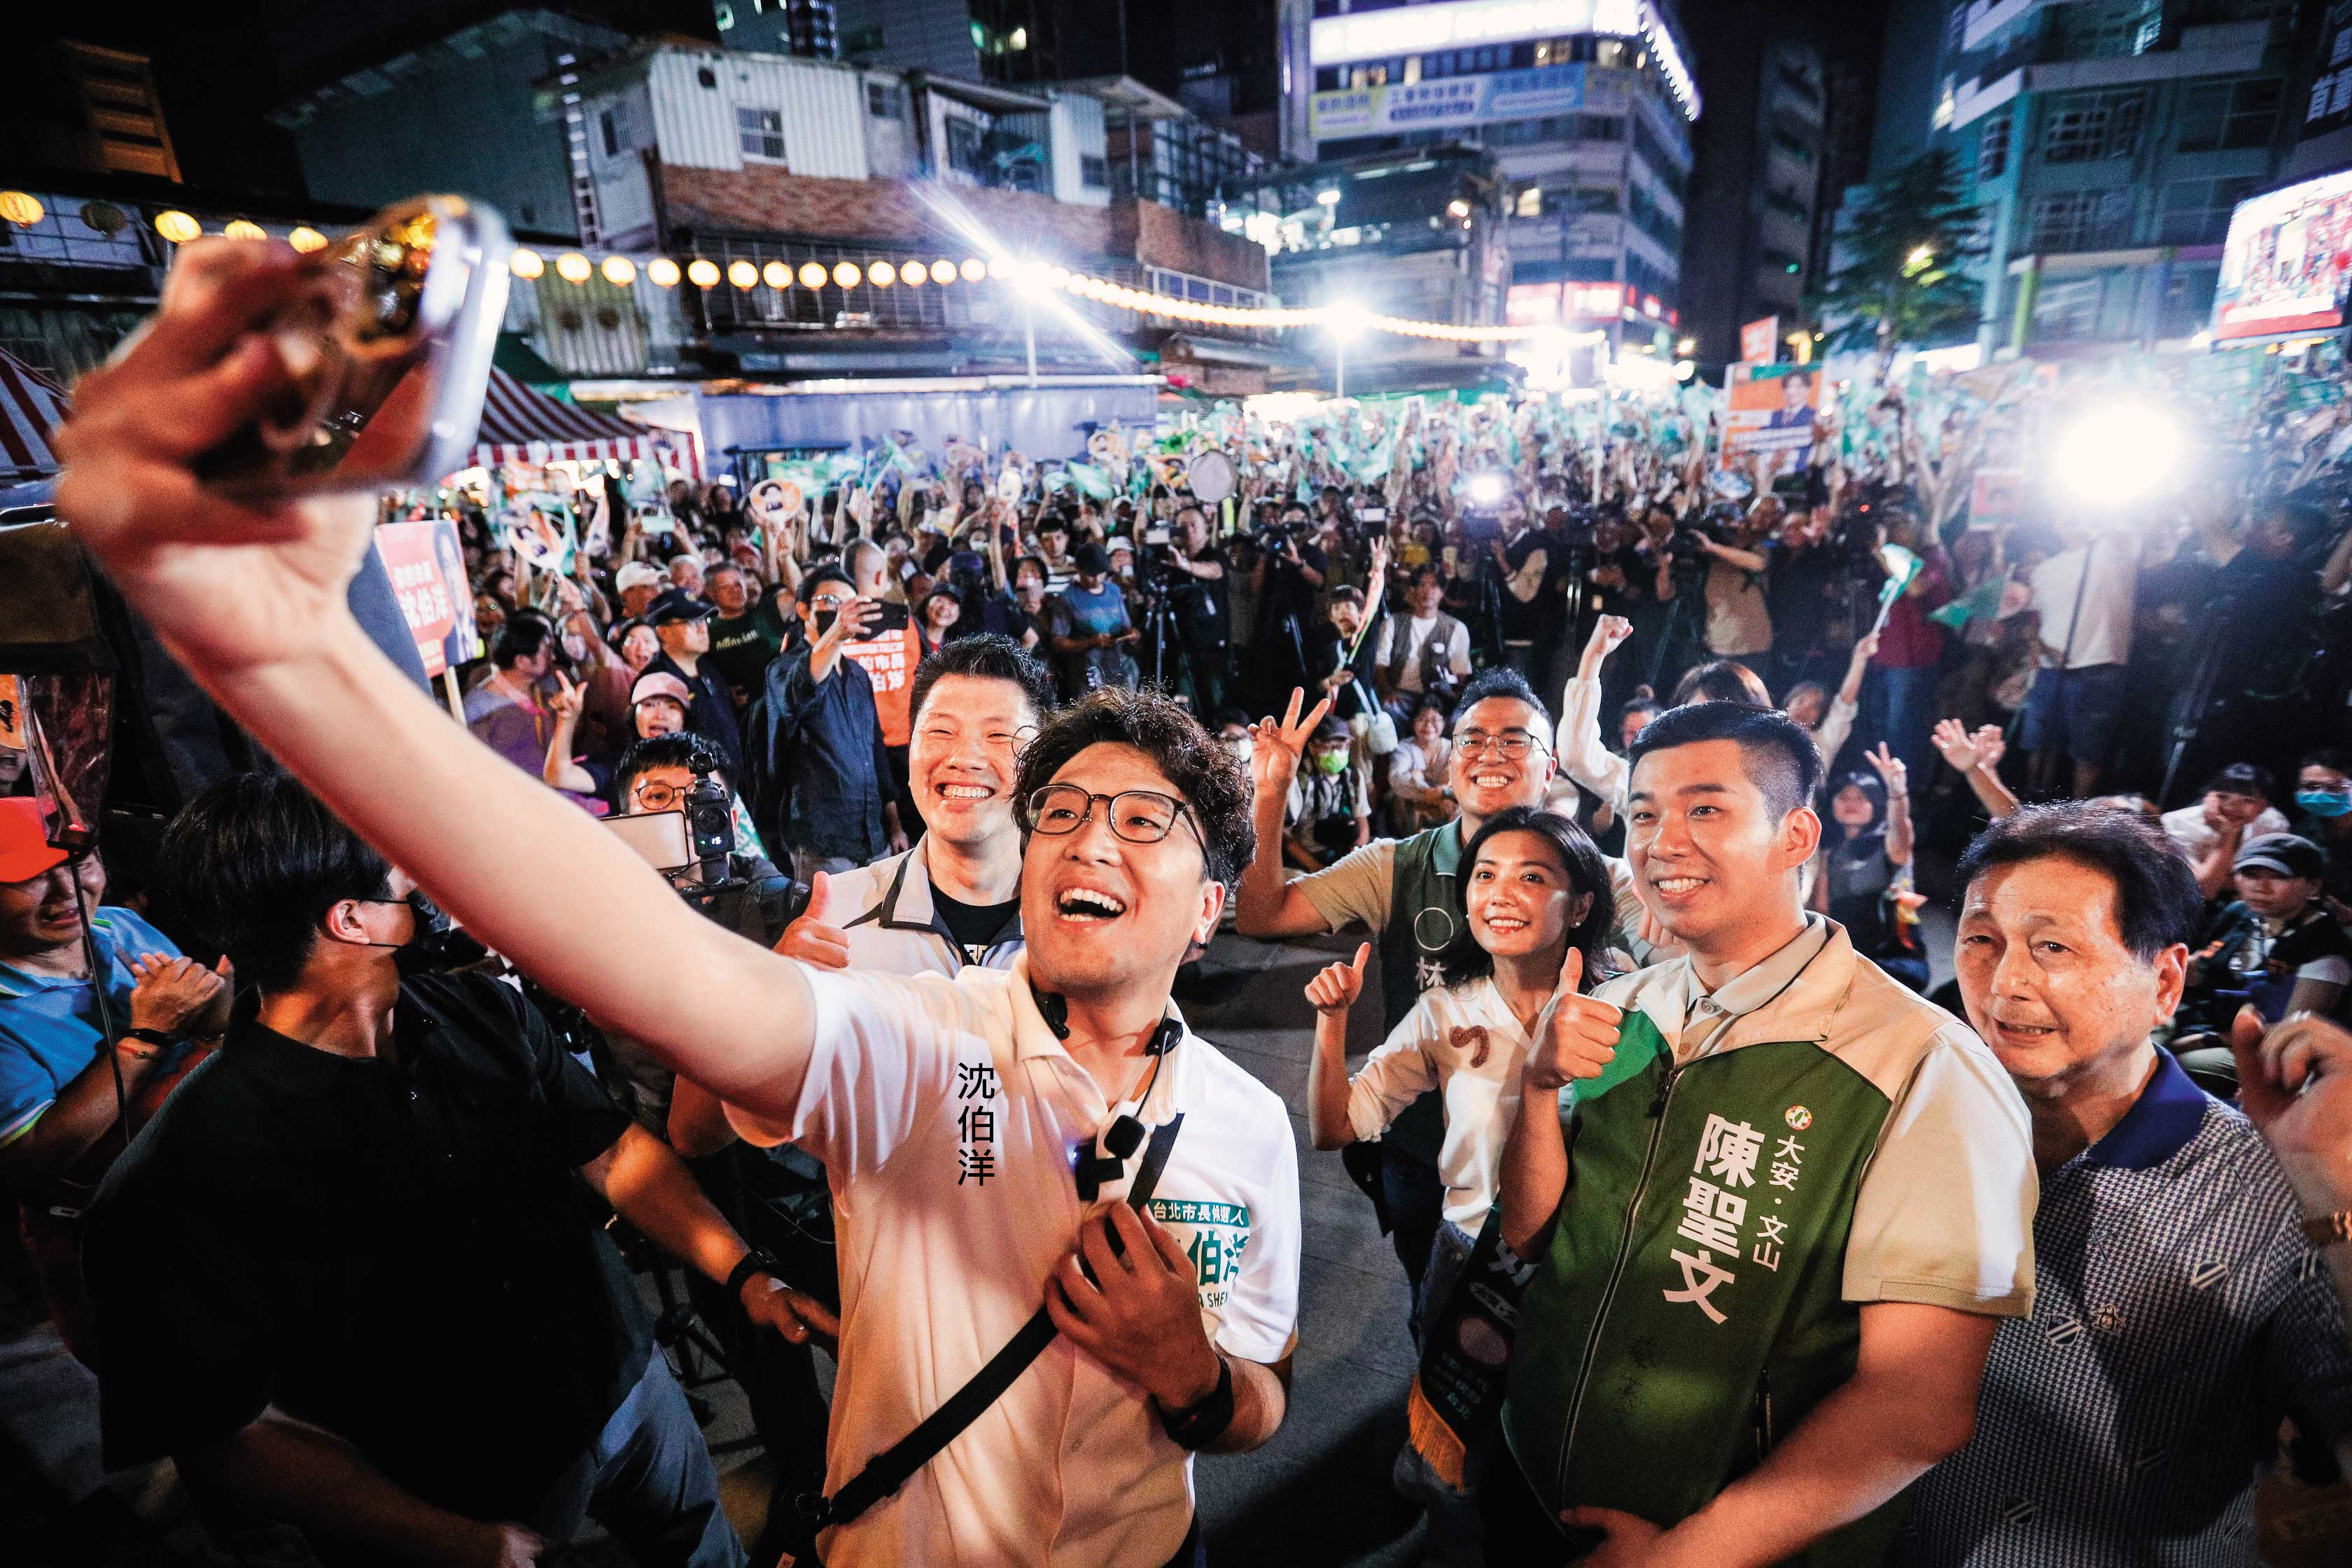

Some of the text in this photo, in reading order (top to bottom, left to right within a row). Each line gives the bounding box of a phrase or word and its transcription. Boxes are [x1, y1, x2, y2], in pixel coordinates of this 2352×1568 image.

[1415, 955, 1446, 990] 林
[1154, 1201, 1245, 1226] 台北市長候選人
[1662, 1112, 1766, 1325] 陳聖文
